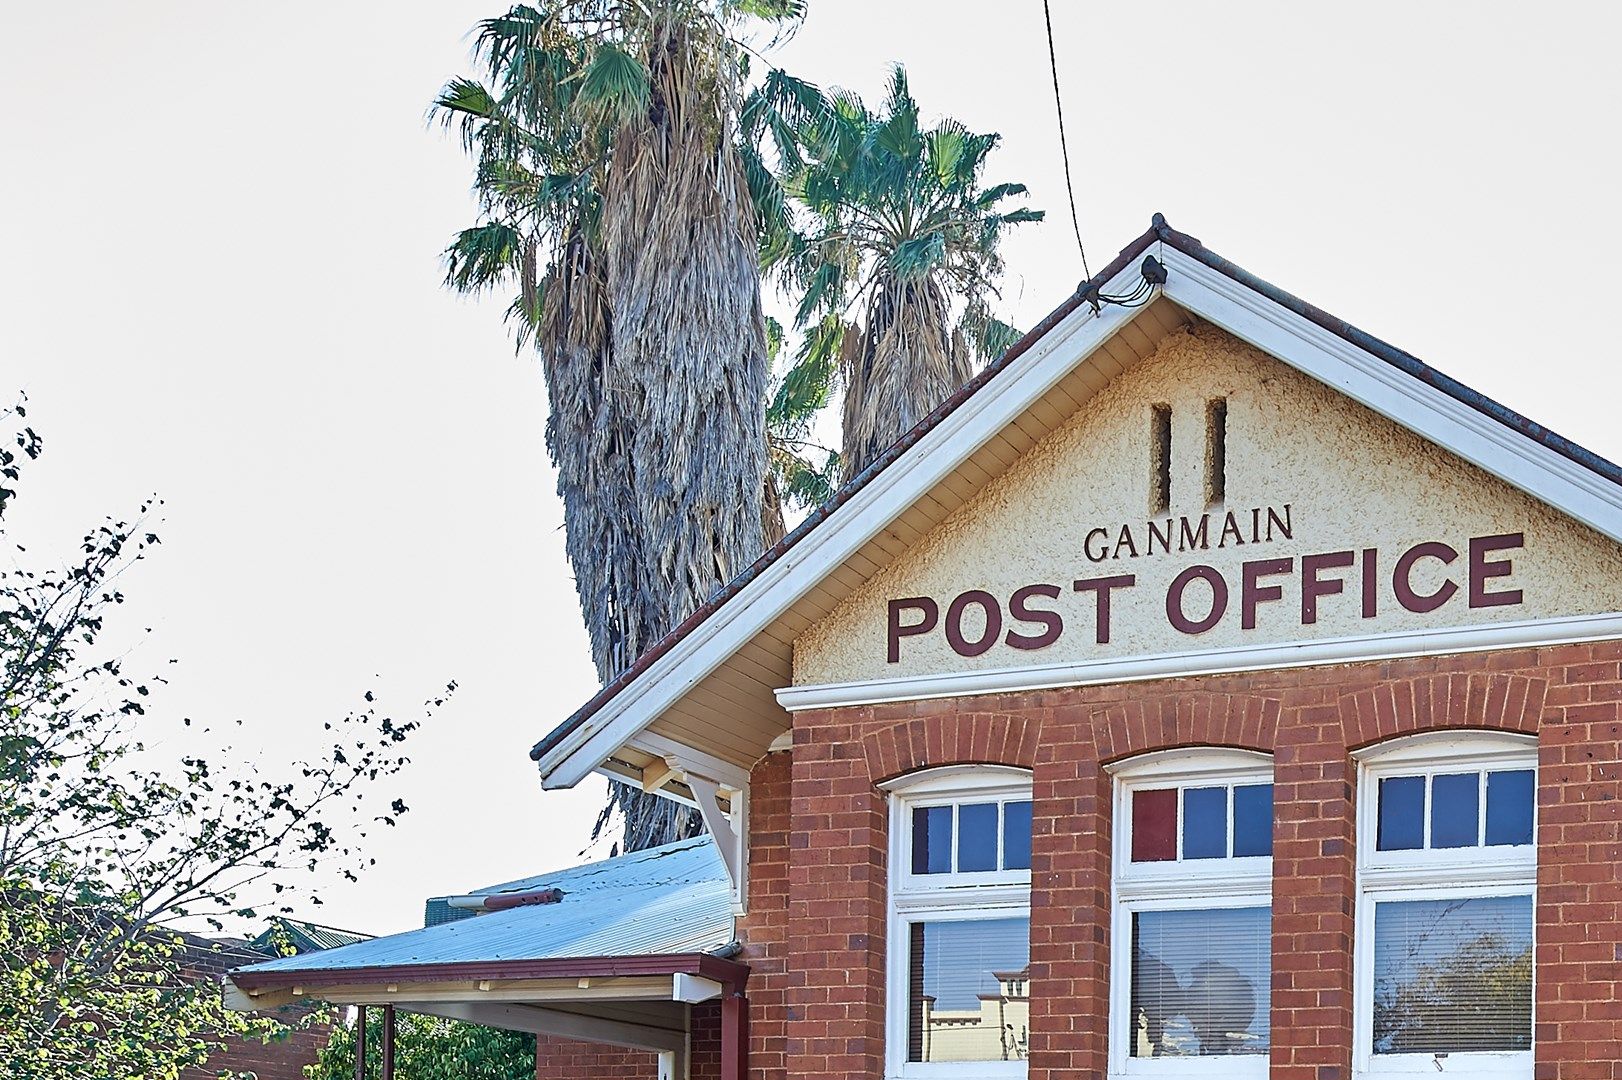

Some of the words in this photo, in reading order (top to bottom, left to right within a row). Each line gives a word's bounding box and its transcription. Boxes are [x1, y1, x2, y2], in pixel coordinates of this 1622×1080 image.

[1083, 504, 1294, 564] GANMAIN
[886, 574, 1136, 664] POST
[1165, 532, 1525, 635] OFFICE
